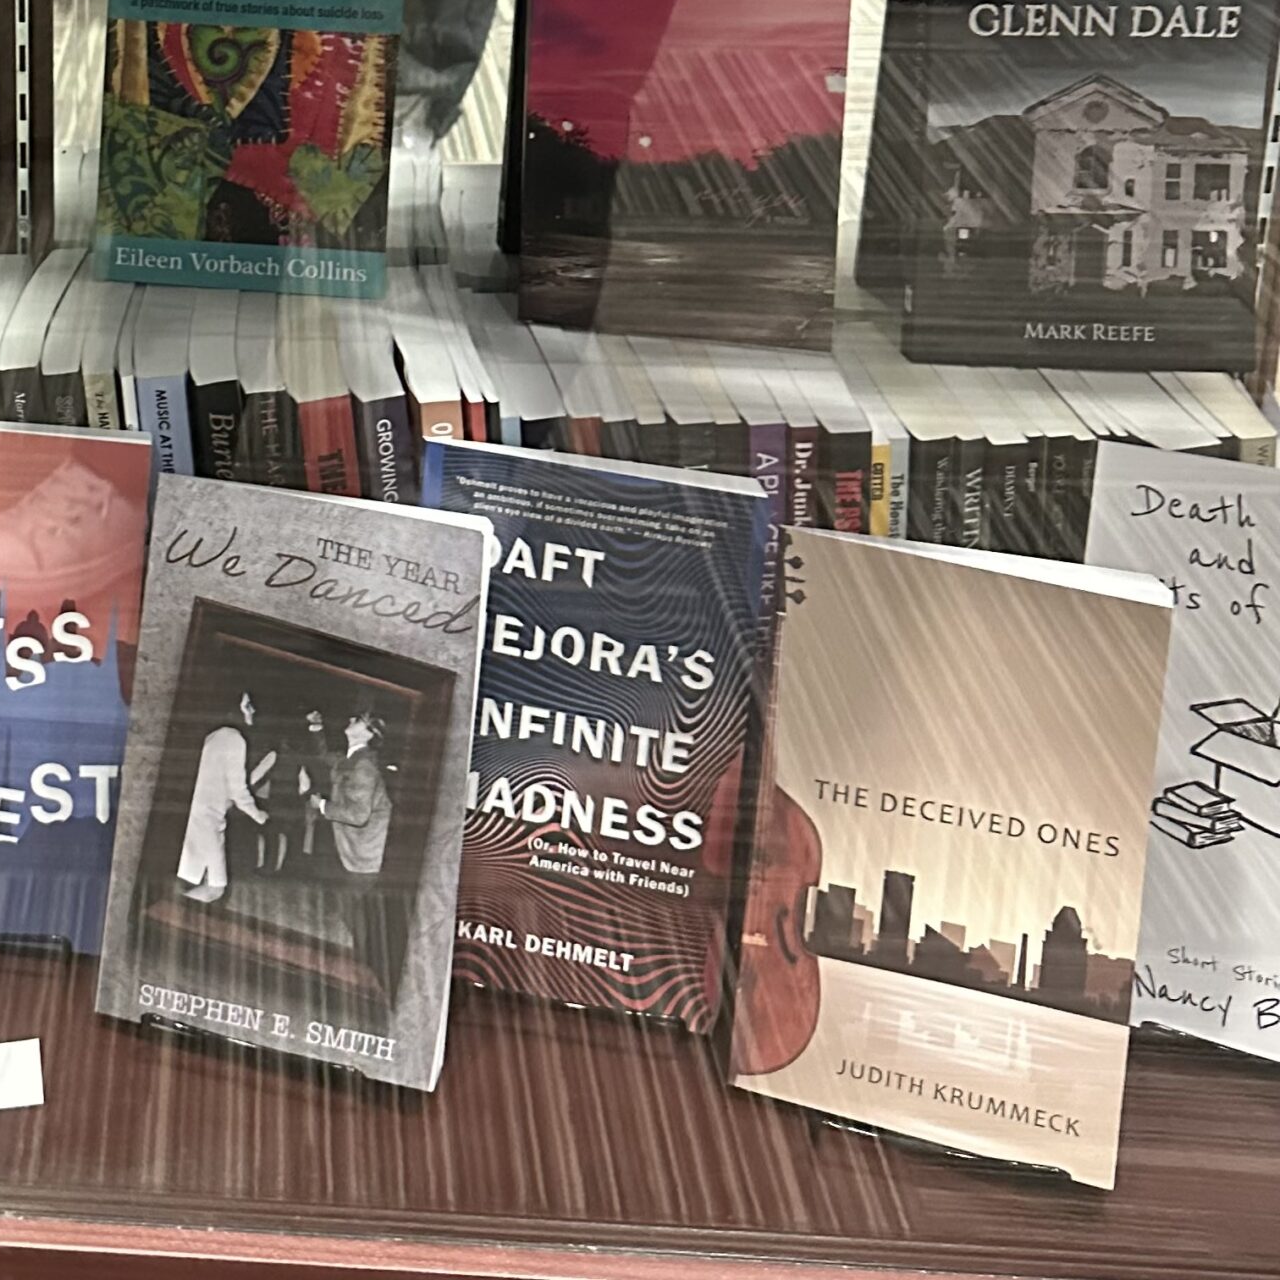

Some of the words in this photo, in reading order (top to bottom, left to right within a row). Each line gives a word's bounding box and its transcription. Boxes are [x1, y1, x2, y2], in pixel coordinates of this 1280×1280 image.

[239, 3, 280, 16] stories
[281, 5, 316, 18] about
[968, 3, 1114, 39] GLENN
[1130, 6, 1242, 40] DALE
[114, 247, 183, 270] Eileen
[188, 251, 280, 277] Vorbach
[286, 257, 368, 283] Collins
[1024, 322, 1087, 341] MARK
[1092, 323, 1156, 343] REEFE
[155, 388, 172, 431] MUSIC
[158, 433, 174, 451] AT
[374, 417, 400, 503] GROWING
[315, 537, 374, 572] THE
[381, 553, 463, 596] YEAR
[814, 777, 870, 809] THE
[880, 792, 1026, 838] DECEIVED
[1036, 822, 1121, 859] ONES
[528, 855, 591, 880] America
[593, 865, 626, 883] with
[629, 871, 691, 898] Friends)
[557, 841, 590, 859] How
[592, 847, 609, 862] to
[611, 850, 657, 872] Travel
[659, 859, 696, 879] Near
[457, 919, 518, 951] KARL
[524, 932, 635, 973] DEHMELT
[137, 982, 265, 1034] STEPHEN
[269, 1013, 297, 1041] E.
[305, 1021, 398, 1063] SMITH
[836, 1057, 925, 1097] JUDITH
[933, 1083, 1082, 1138] KRUMMECK
